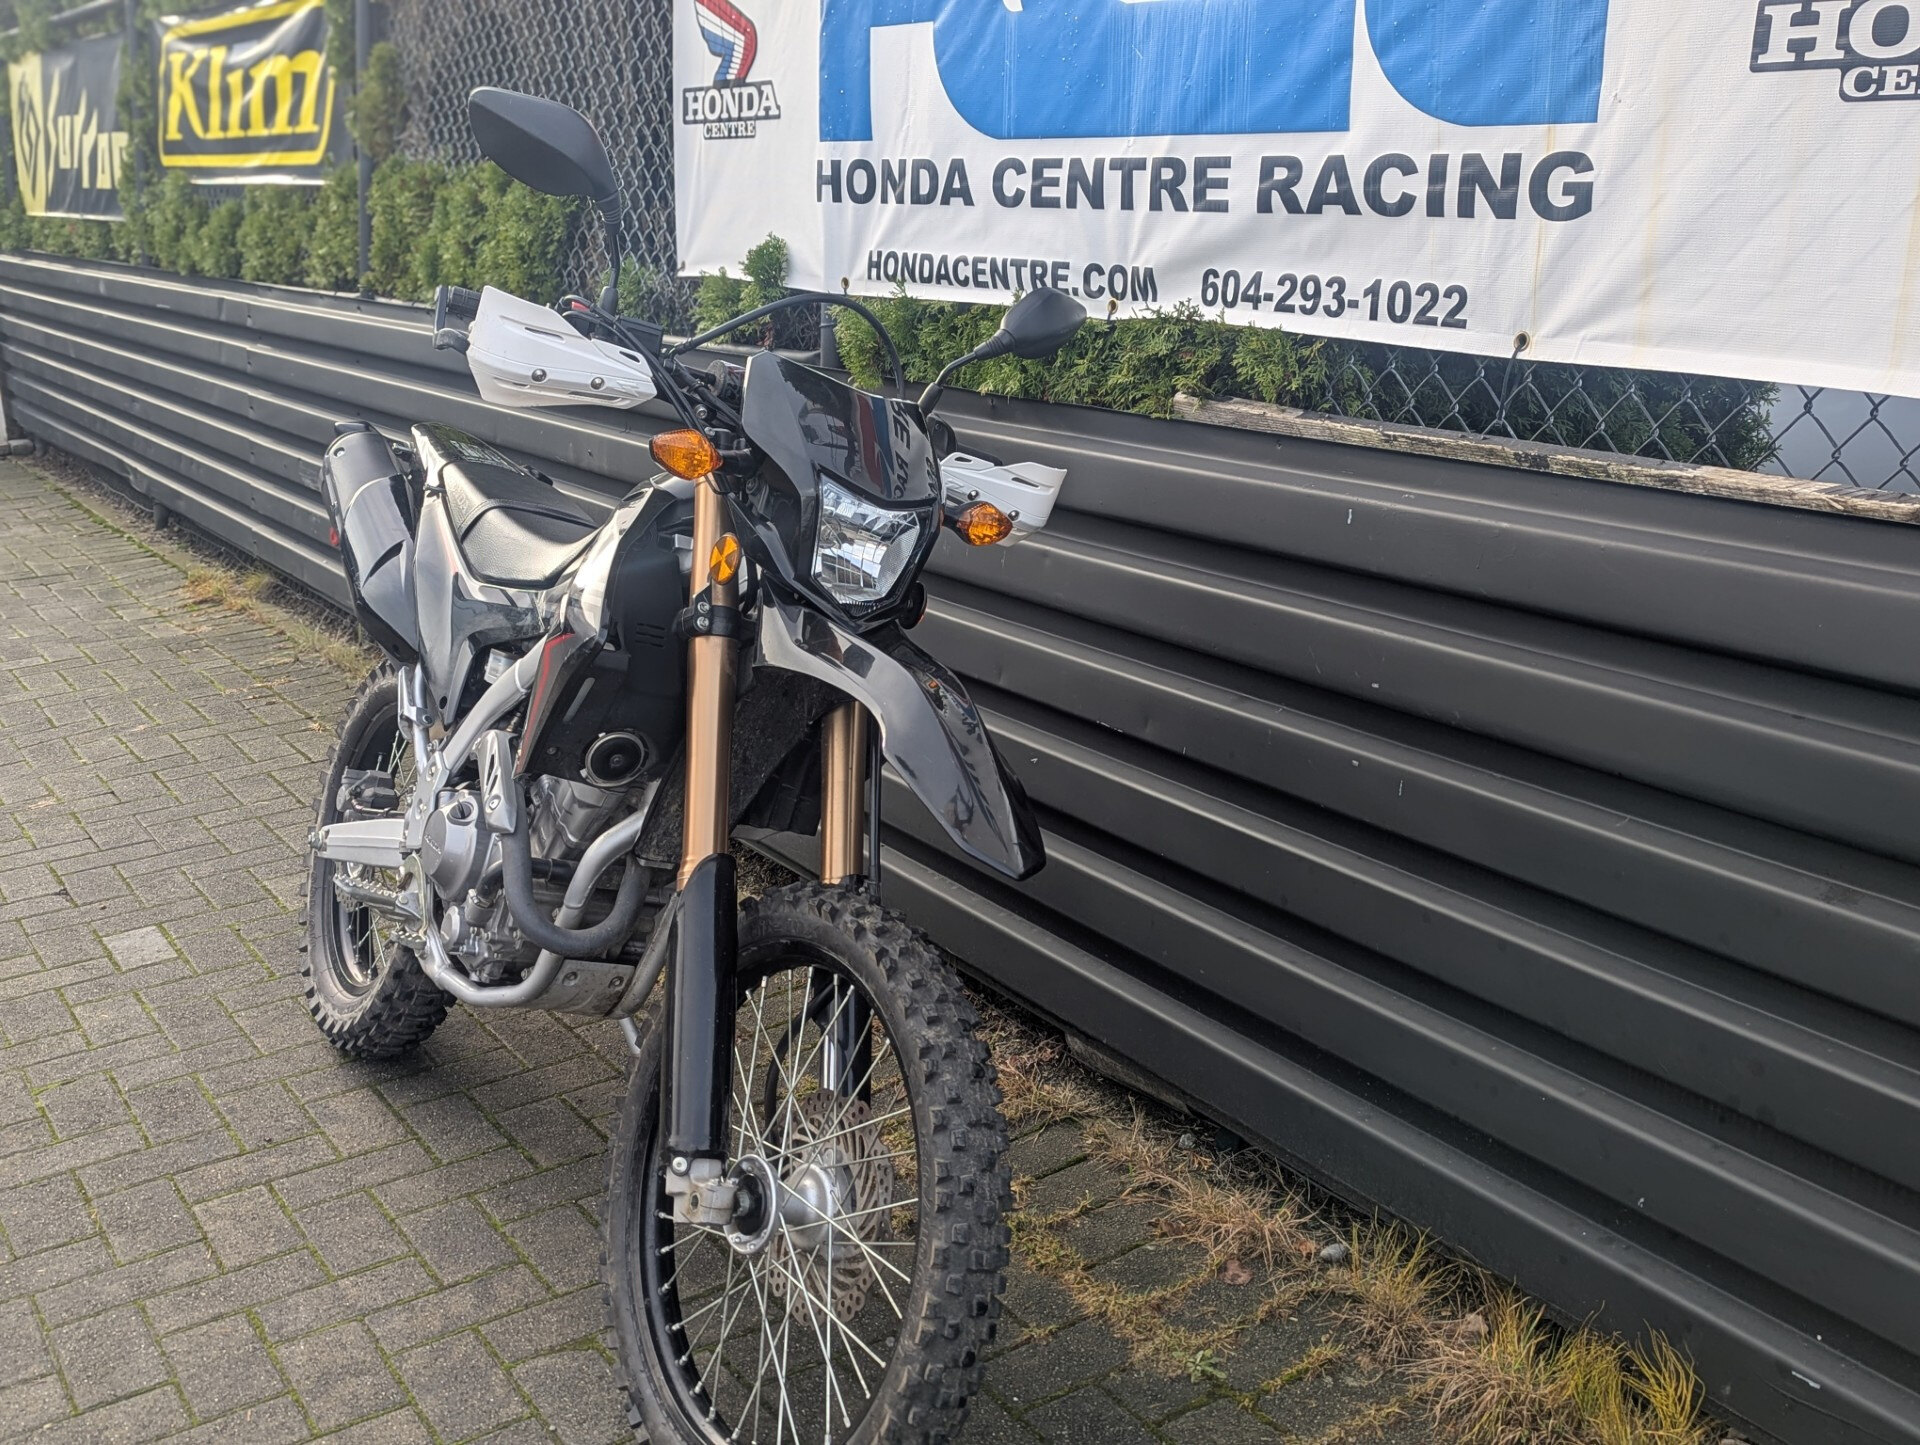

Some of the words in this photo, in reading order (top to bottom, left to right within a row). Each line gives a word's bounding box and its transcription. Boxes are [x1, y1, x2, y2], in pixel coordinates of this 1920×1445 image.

[166, 45, 320, 141] Klim
[685, 84, 780, 120] HONDA
[1842, 65, 1920, 98] CE
[703, 121, 756, 138] CENTRE
[816, 158, 975, 207] HONDA
[992, 156, 1232, 213] CENTRE
[1256, 151, 1595, 222] RACING
[867, 250, 1159, 303] HONDACENTRE.COM
[1201, 267, 1468, 330] 604-293-1022
